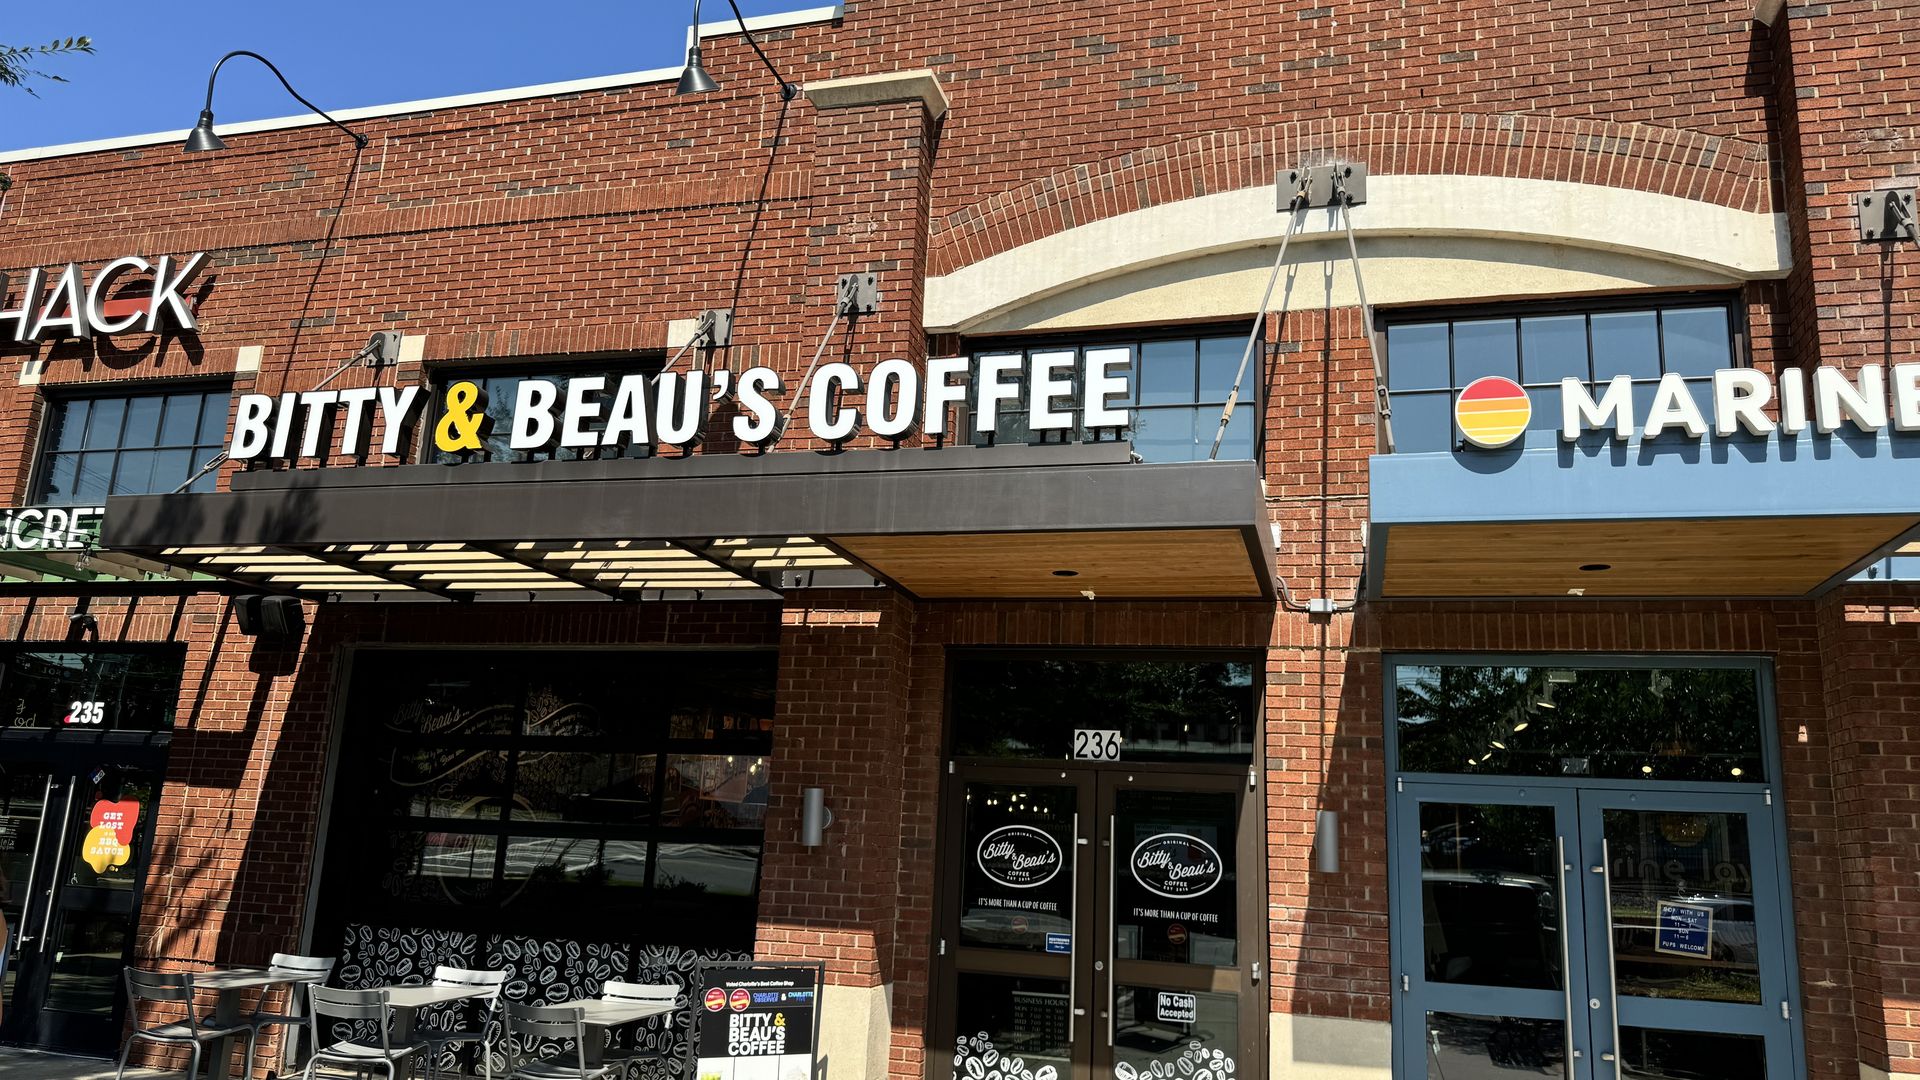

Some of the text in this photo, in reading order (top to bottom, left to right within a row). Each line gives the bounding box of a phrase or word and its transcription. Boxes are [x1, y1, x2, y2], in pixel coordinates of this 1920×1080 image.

[228, 347, 1132, 459] BITTY & BEAU'S COFFEE
[69, 700, 105, 724] 235
[1075, 731, 1119, 760] 236
[103, 812, 124, 820] GET
[99, 821, 124, 830] LOST
[90, 847, 124, 856] SAUCE
[983, 841, 1056, 870] Bitty & Beau's
[1137, 850, 1216, 880] Bitty & Beau's
[978, 897, 1057, 911] IT'S MORE THAN A CUP OF COFFEE
[1133, 907, 1218, 923] IT'S MORE THAN A CUP OF COFFEE
[1679, 944, 1705, 952] WELCOME
[781, 992, 787, 1001] &
[1160, 995, 1193, 1008] No Cash
[729, 1012, 786, 1028] BITTY &
[1160, 1008, 1194, 1019] Accepted
[729, 1026, 786, 1042] BEAU'S
[728, 1040, 785, 1056] COFFEE
